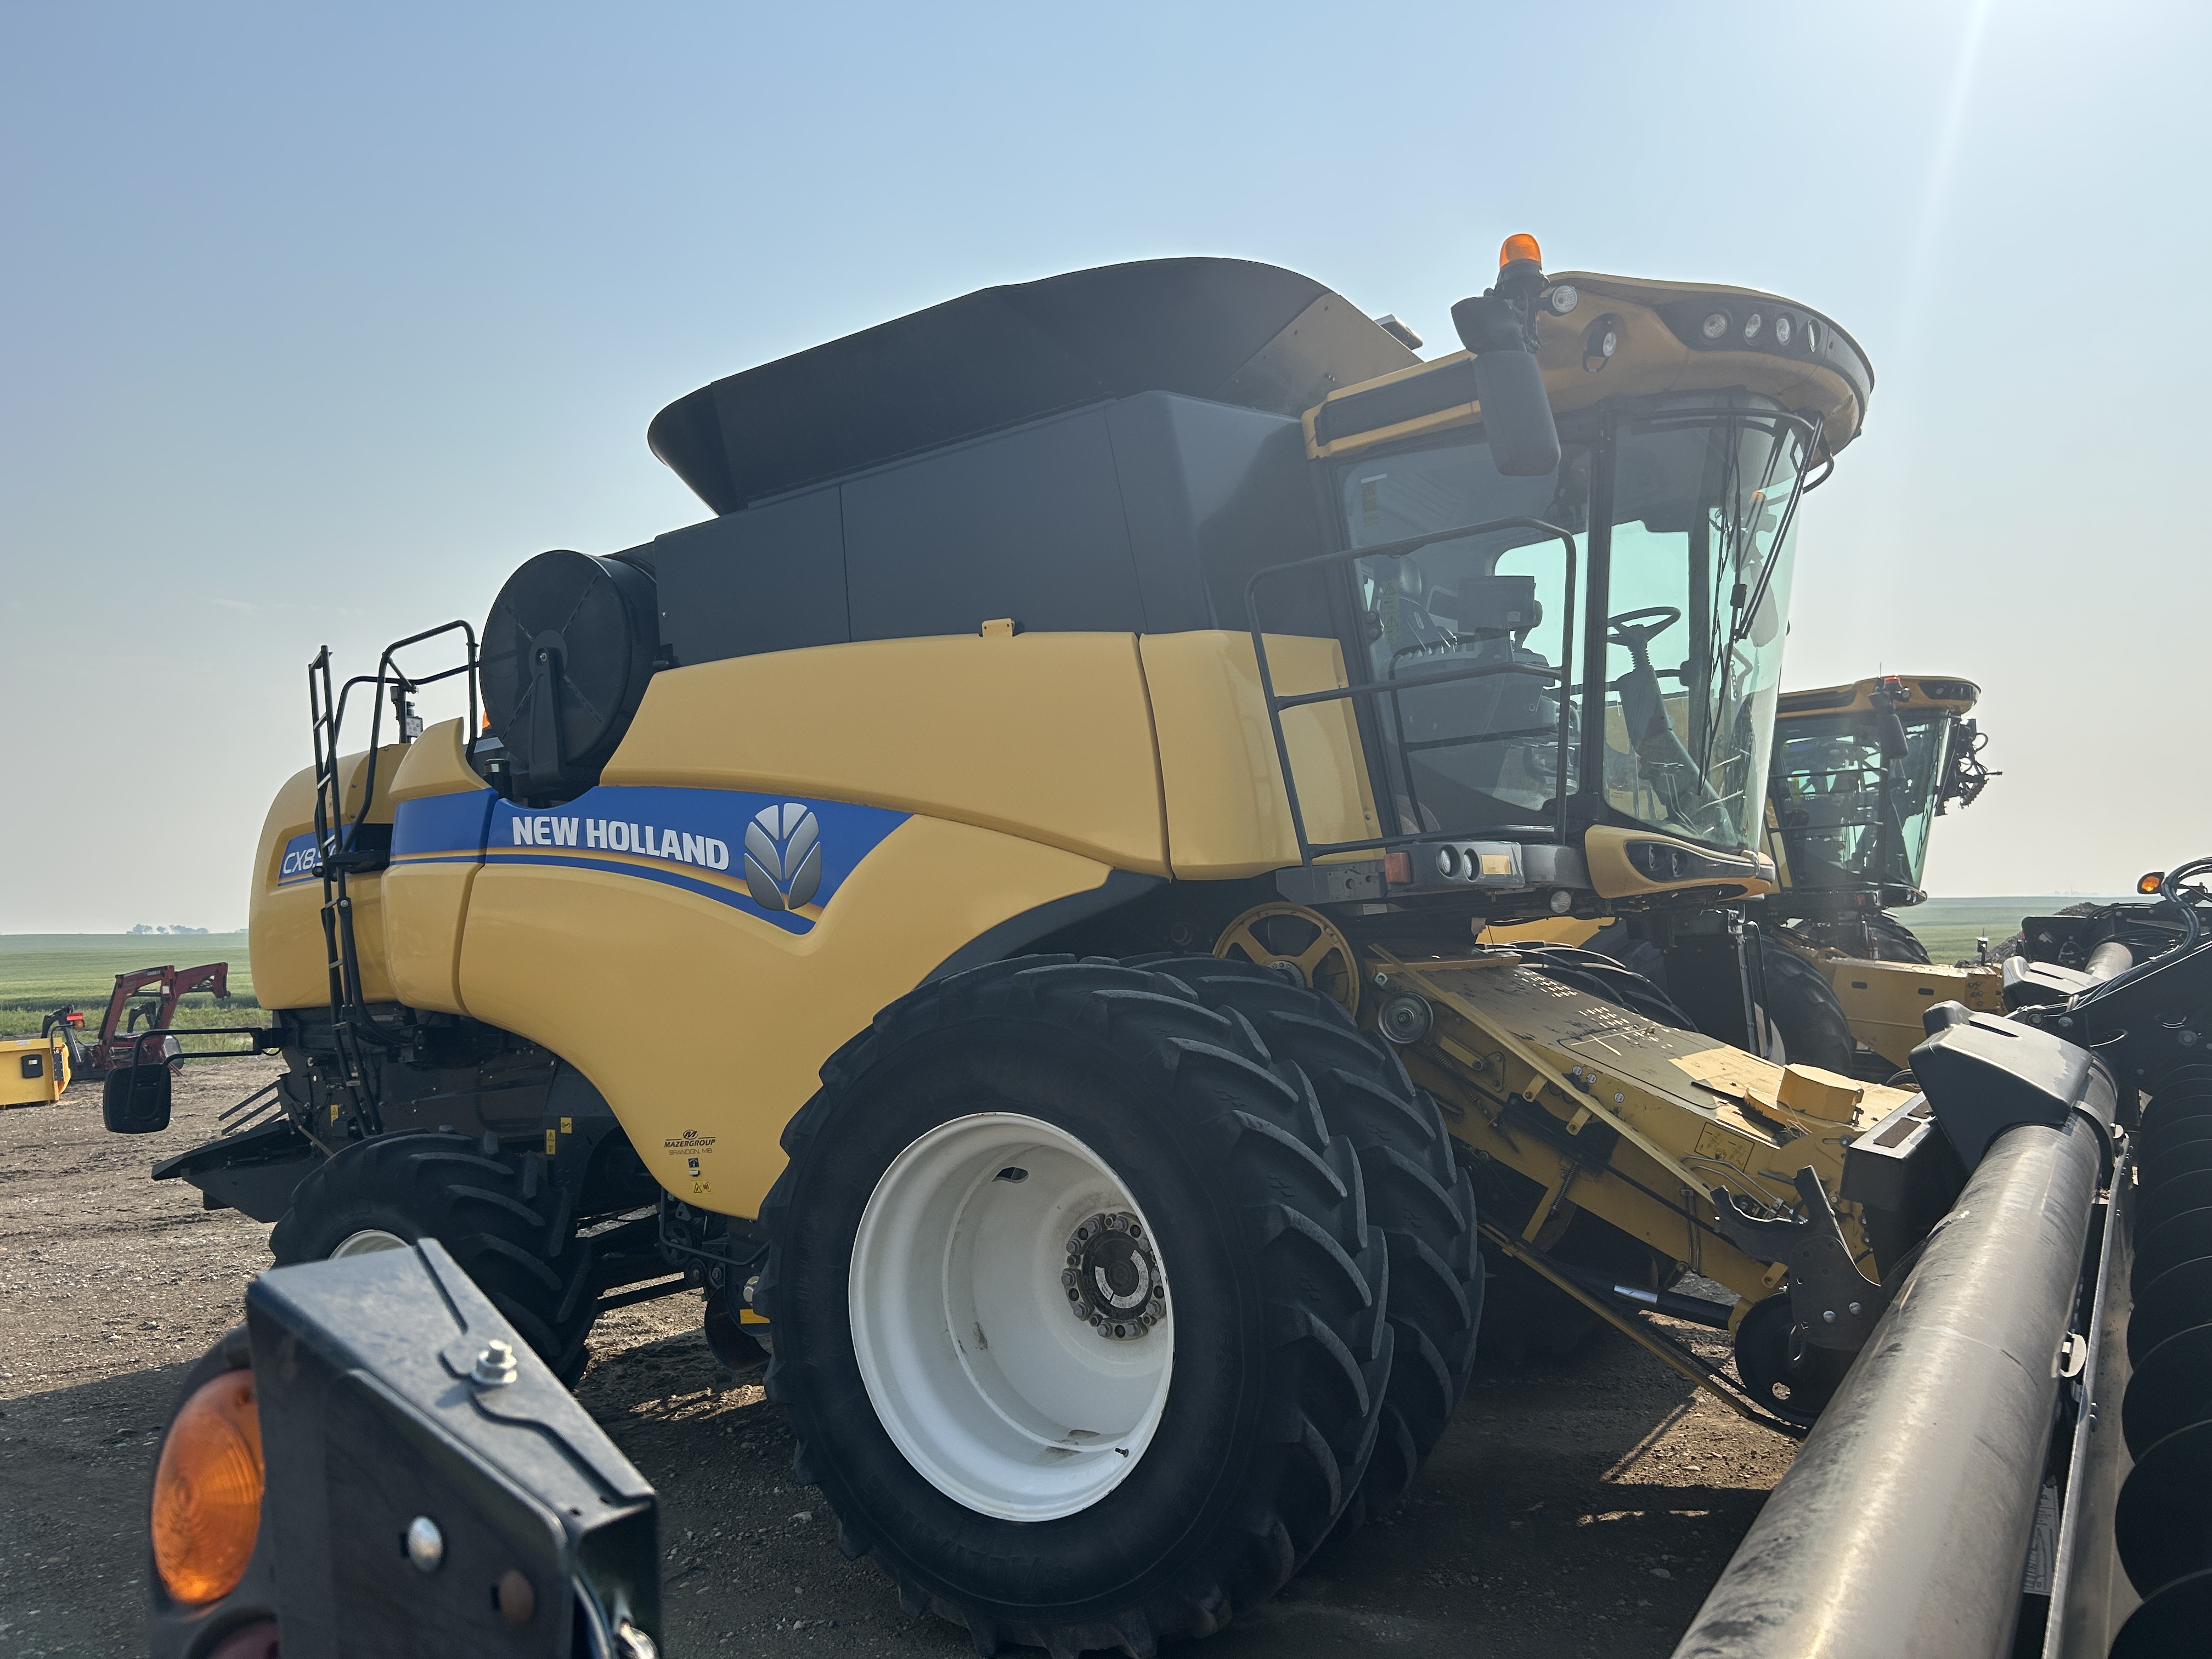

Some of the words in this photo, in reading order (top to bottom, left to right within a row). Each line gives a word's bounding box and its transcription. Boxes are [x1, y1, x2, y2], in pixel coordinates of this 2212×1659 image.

[512, 816, 579, 847] NEW
[586, 818, 730, 871] HOLLAND
[283, 844, 336, 874] CX8.
[664, 1139, 715, 1148] MAZERGROUP
